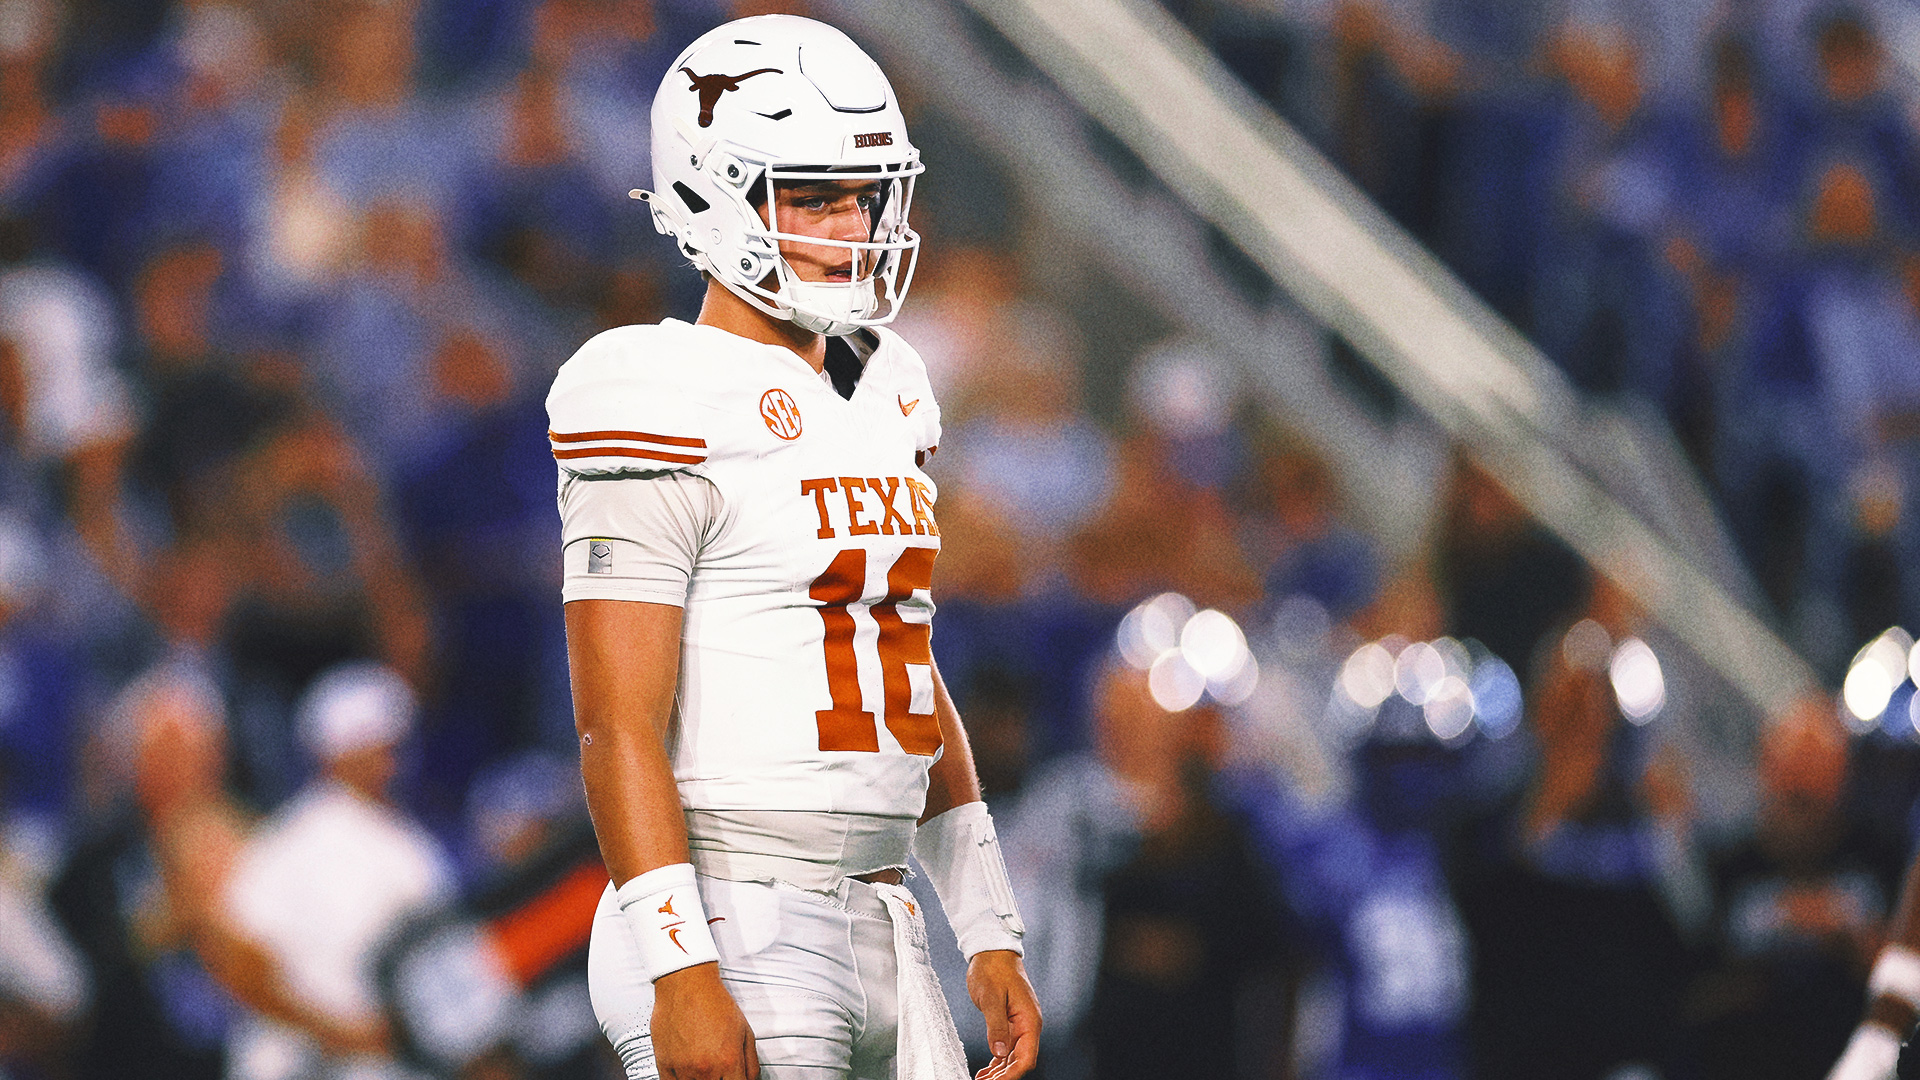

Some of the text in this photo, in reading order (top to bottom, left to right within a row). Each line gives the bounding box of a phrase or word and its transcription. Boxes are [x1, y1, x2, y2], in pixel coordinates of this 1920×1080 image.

[853, 132, 893, 148] HORNS
[760, 388, 802, 440] SEC
[809, 547, 944, 756] 16
